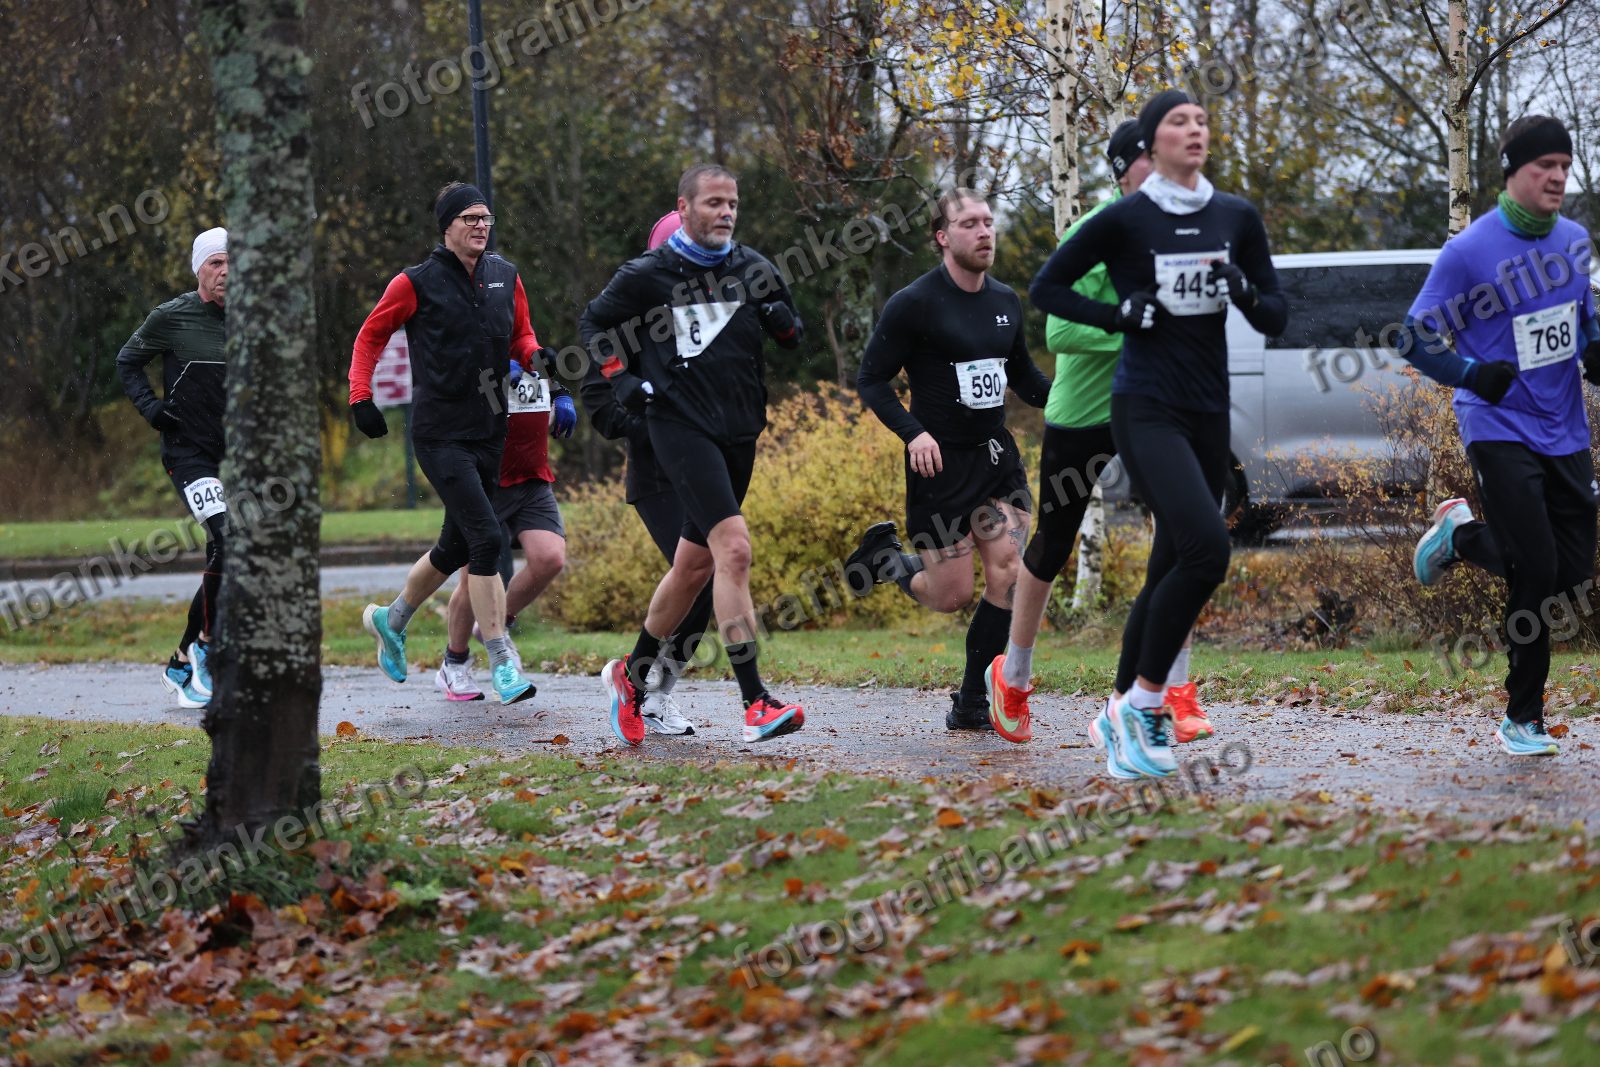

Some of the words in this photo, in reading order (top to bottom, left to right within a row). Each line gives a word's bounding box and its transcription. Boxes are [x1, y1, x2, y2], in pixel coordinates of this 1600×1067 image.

[1173, 271, 1219, 299] 445
[1529, 321, 1571, 354] 768
[518, 383, 544, 403] 824
[972, 372, 1001, 399] 590
[193, 485, 225, 511] 948
